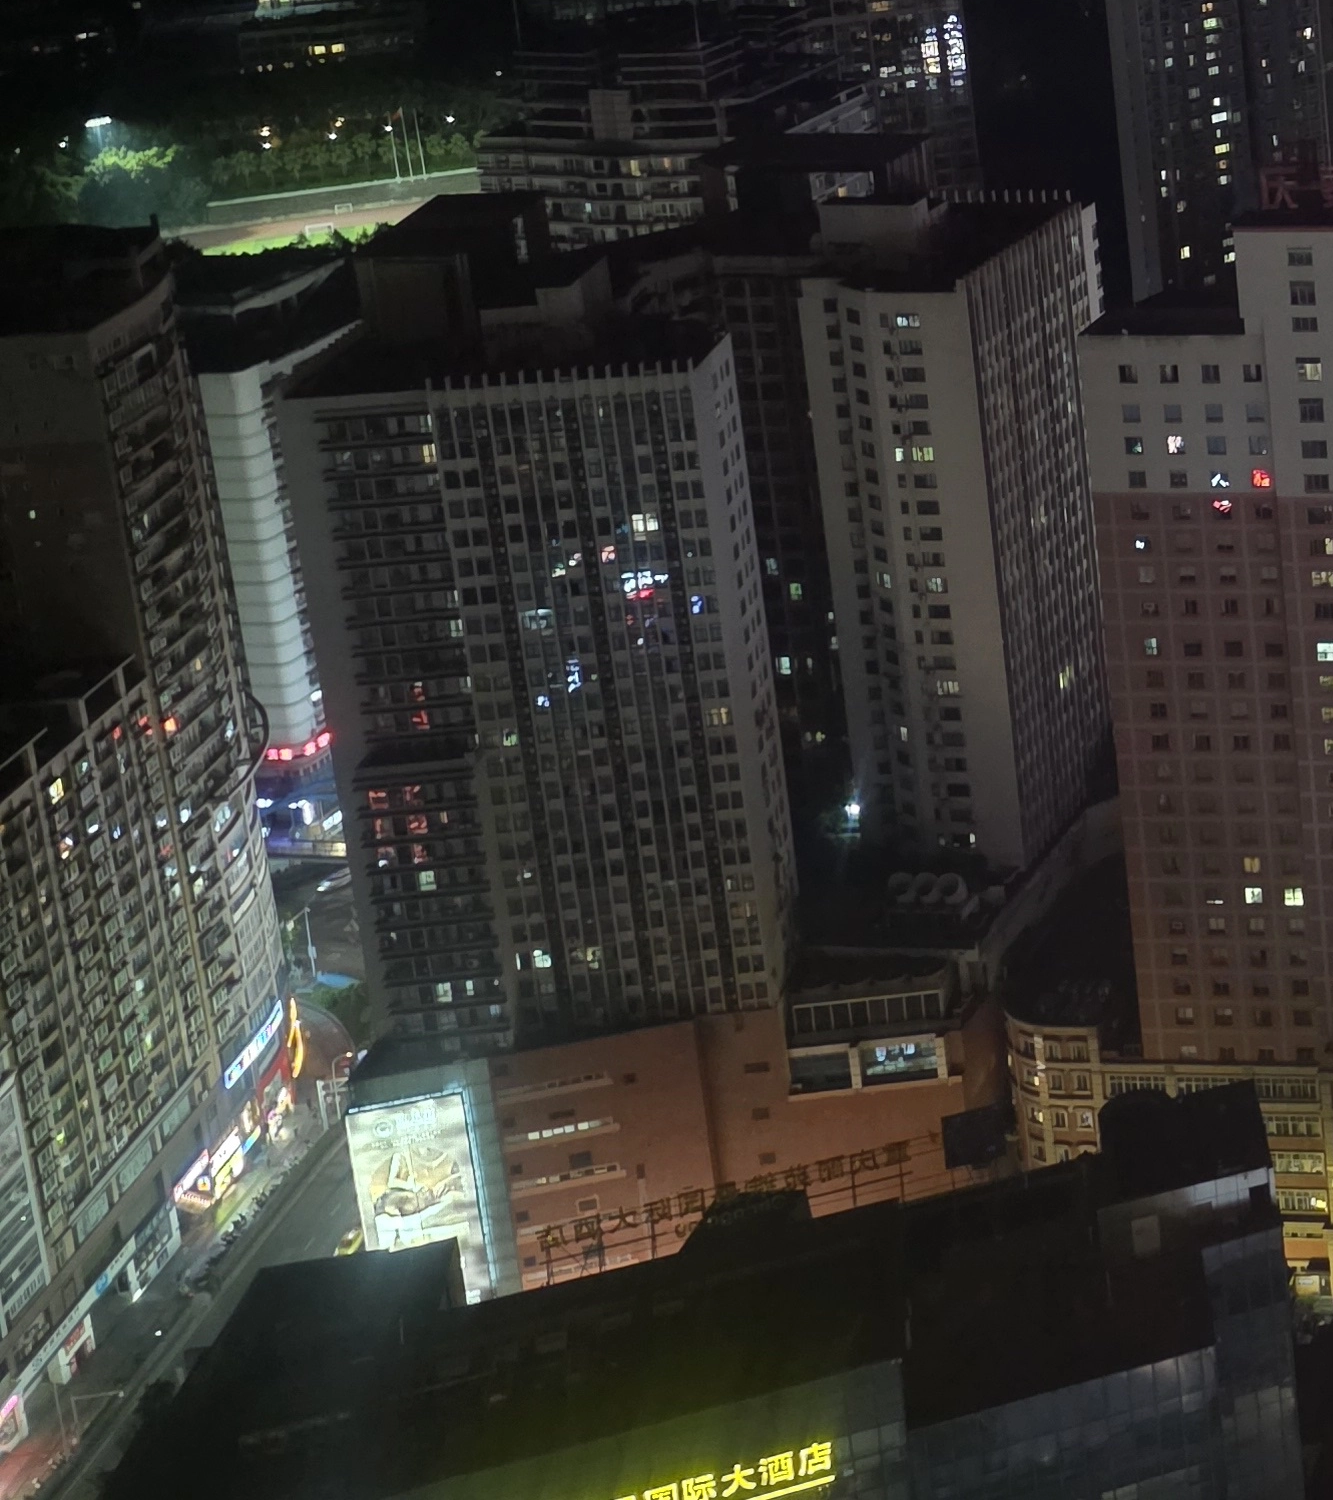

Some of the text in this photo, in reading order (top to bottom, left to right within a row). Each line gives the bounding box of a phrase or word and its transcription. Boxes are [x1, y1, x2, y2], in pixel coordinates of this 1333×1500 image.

[613, 1441, 833, 1500] 国际大酒店
